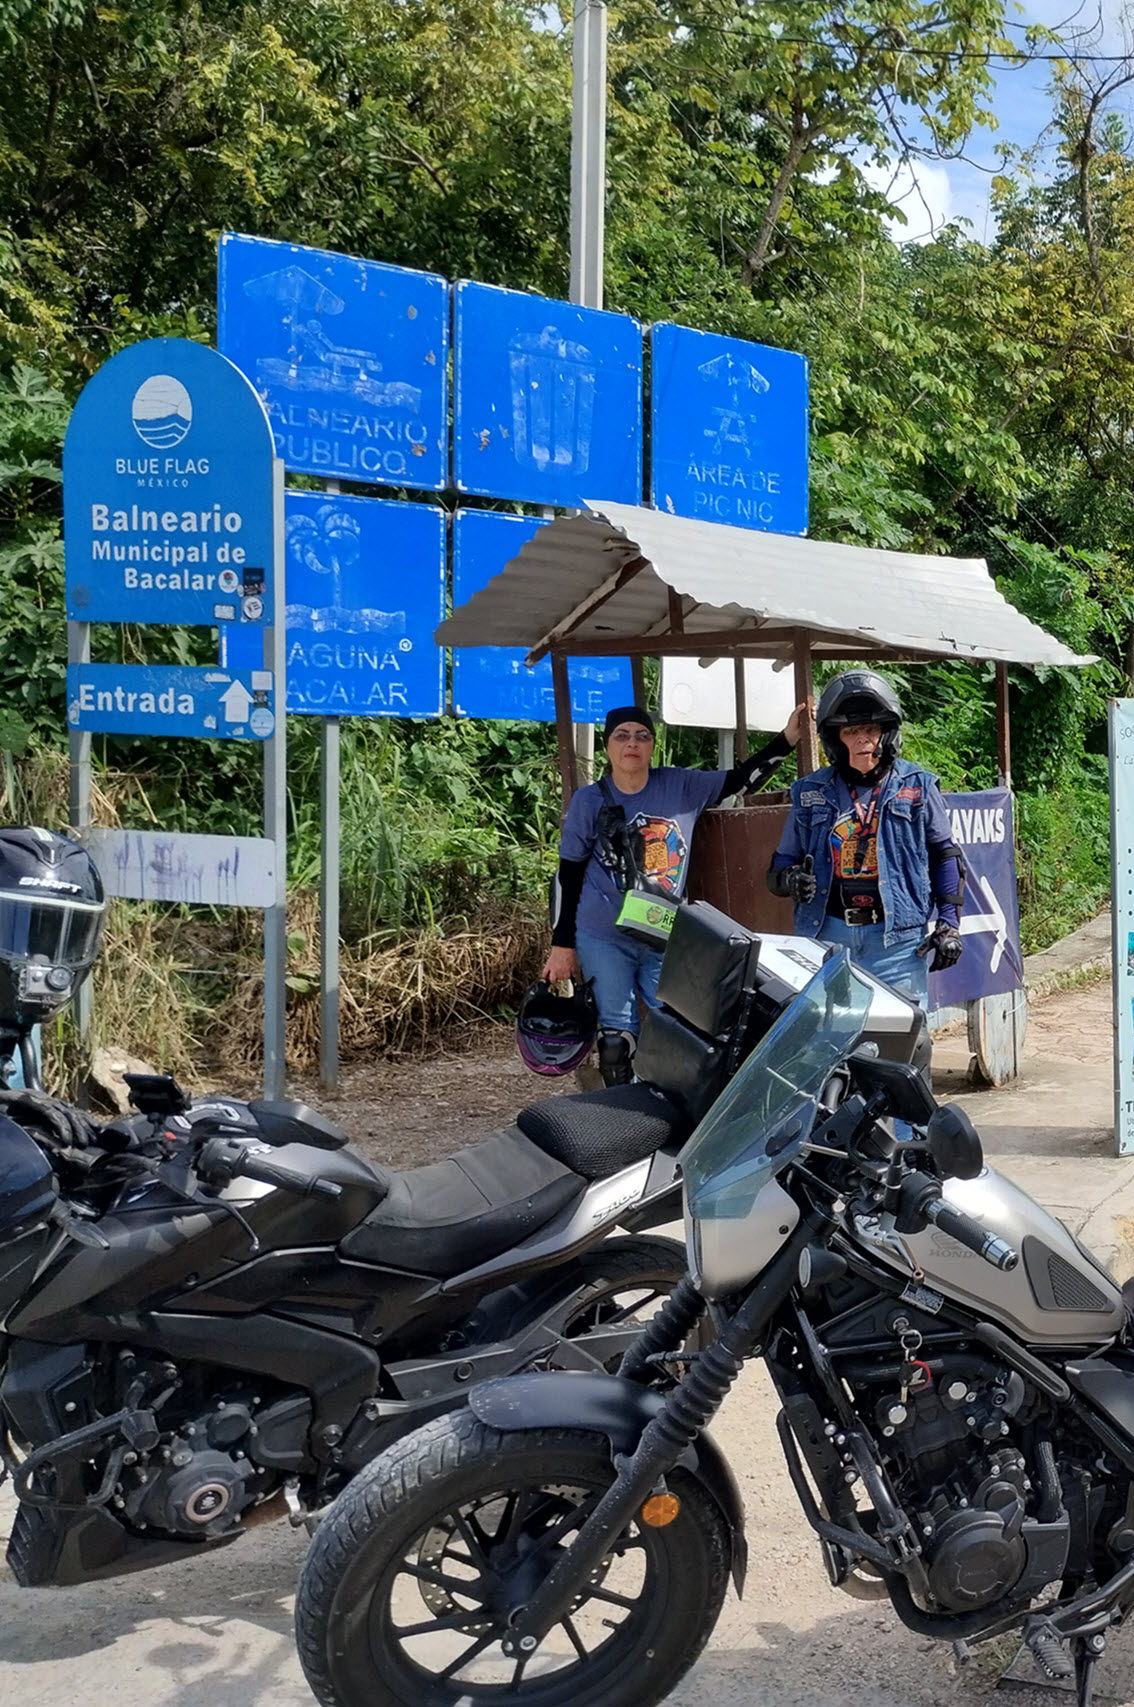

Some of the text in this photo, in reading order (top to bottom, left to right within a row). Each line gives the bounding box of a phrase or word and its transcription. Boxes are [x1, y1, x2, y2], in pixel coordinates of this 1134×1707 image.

[266, 401, 427, 444] ALNEARIO
[116, 459, 210, 474] BLUE FLAG
[752, 470, 780, 494] DE
[92, 504, 242, 533] Balneario
[92, 540, 246, 567] Municipal de
[125, 568, 215, 591] Bacalar
[287, 641, 400, 671] AGUNA
[79, 684, 195, 715] Entrada
[285, 678, 409, 706] ACALAR
[945, 808, 1005, 844] AYAKS
[19, 877, 81, 893] SHAFT
[928, 1248, 979, 1259] HOND
